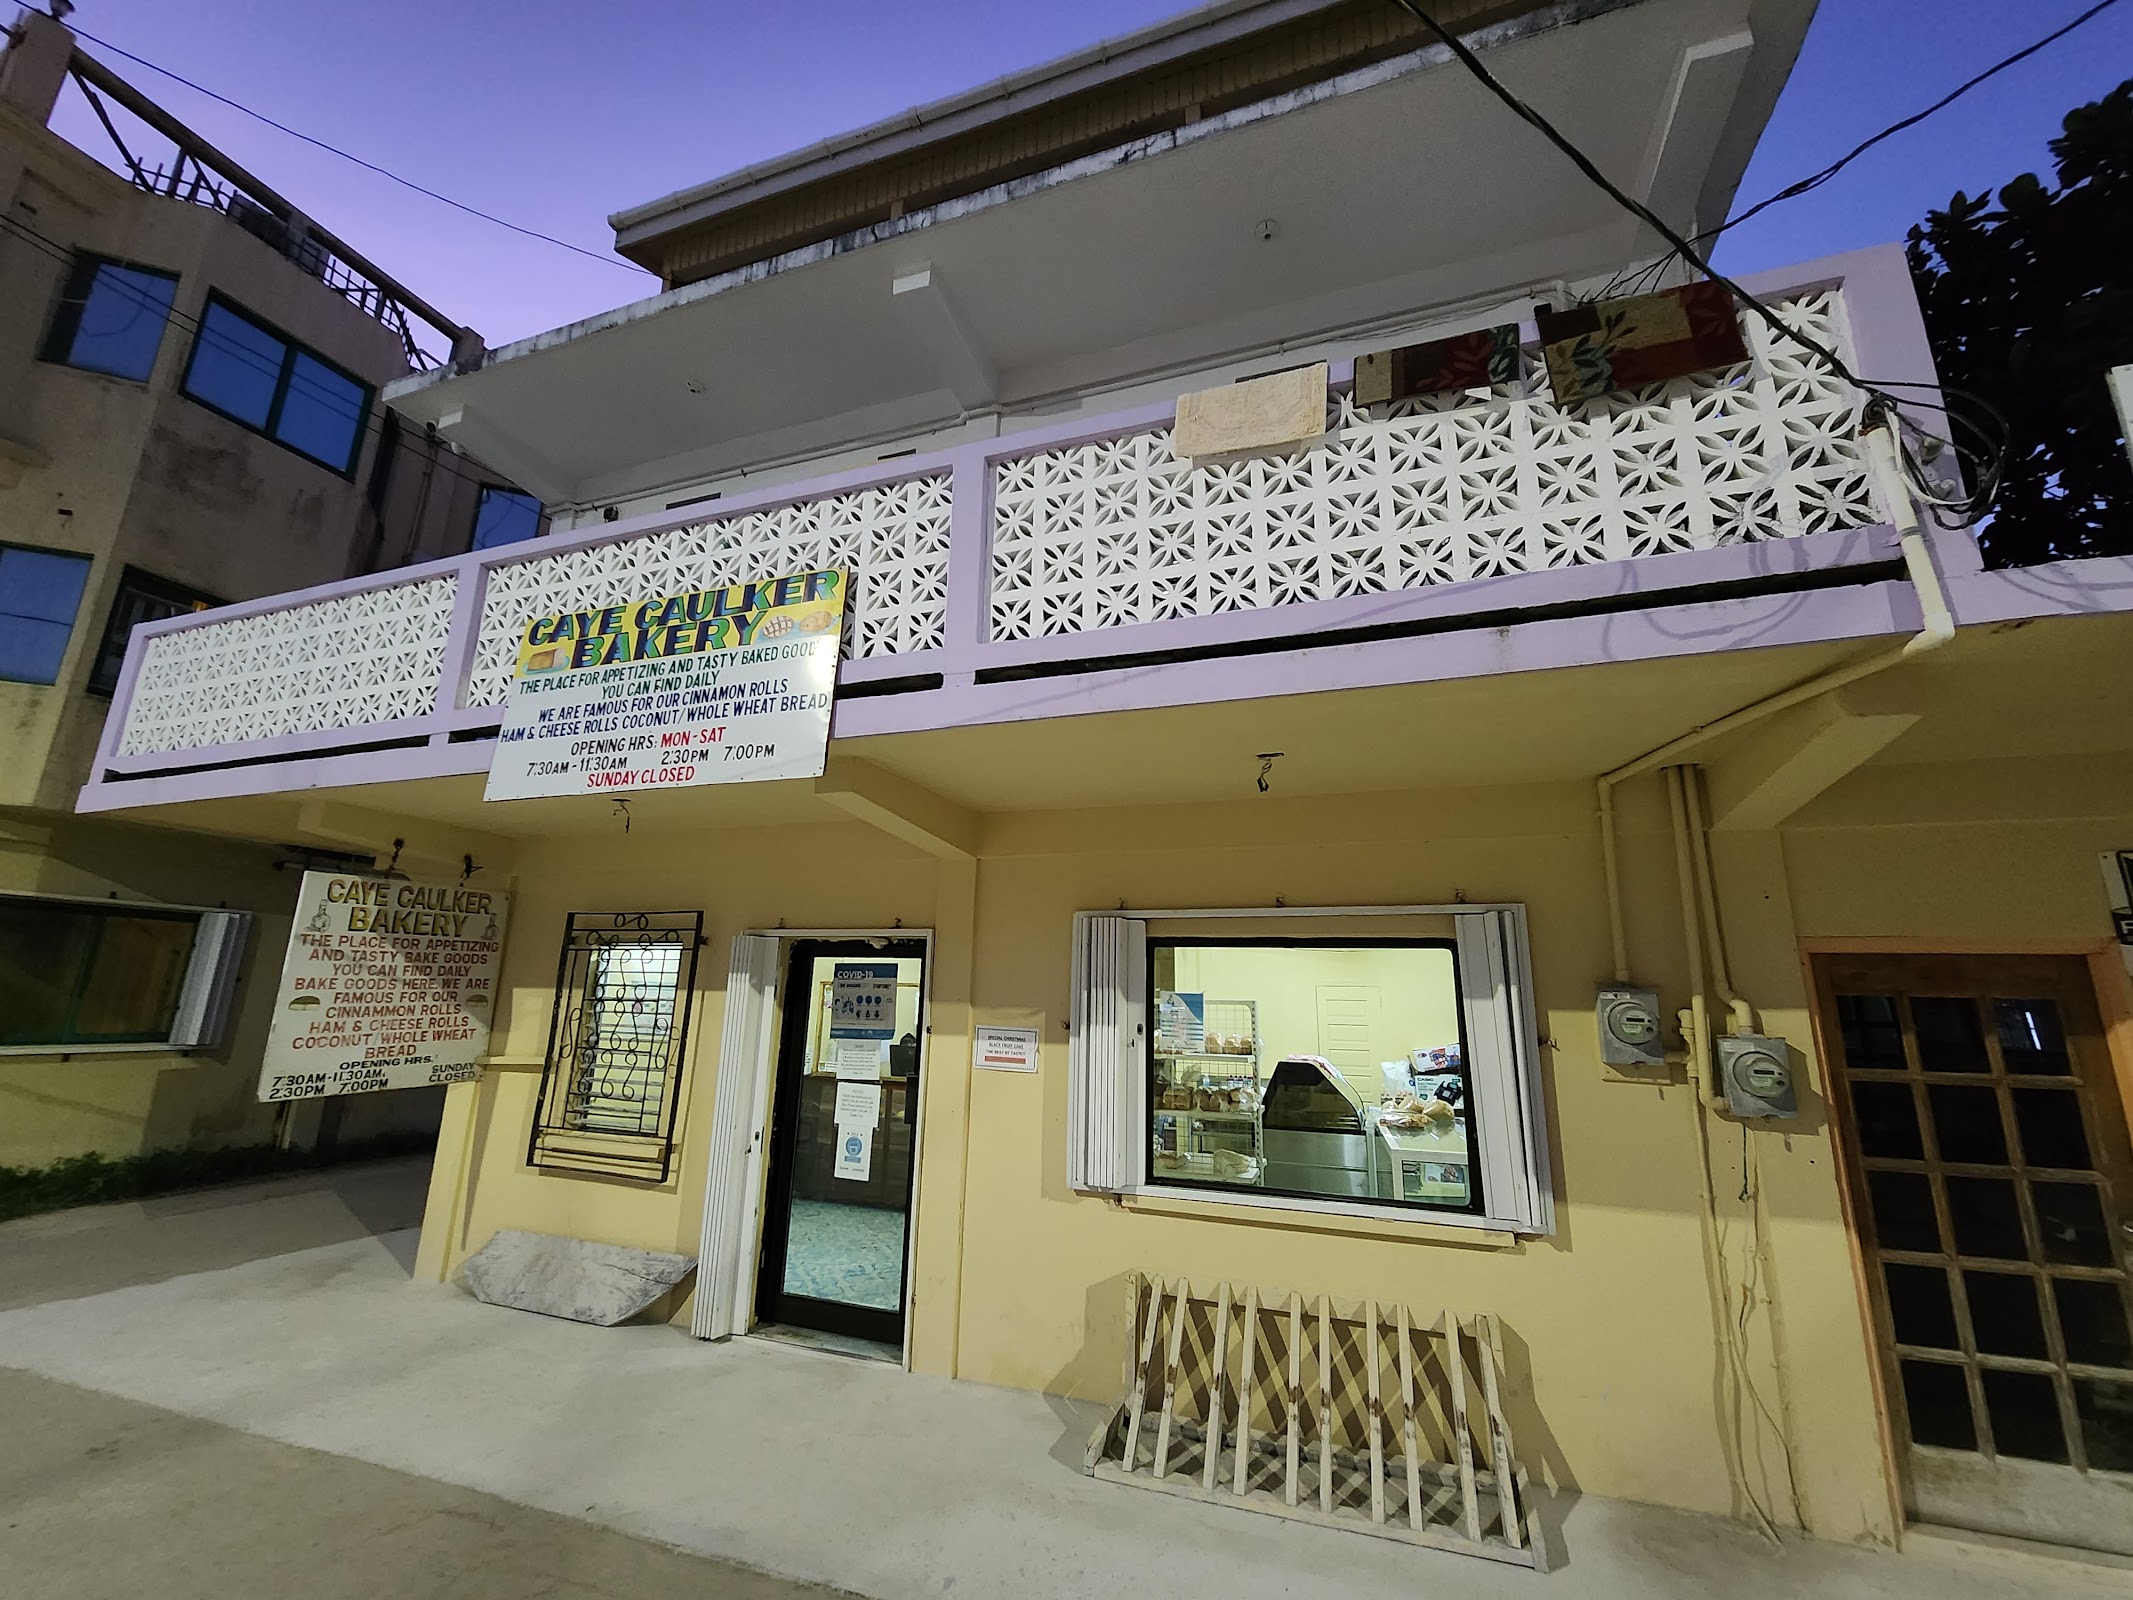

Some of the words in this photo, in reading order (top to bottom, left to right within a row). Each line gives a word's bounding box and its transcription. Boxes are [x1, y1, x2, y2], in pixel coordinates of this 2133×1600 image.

[529, 606, 627, 646] CAYE
[635, 570, 840, 630] CAULKER
[570, 610, 769, 669] BAKERY
[519, 679, 542, 695] THE
[542, 675, 577, 692] PLACE
[578, 671, 600, 687] FOR
[600, 661, 665, 684] APPETIZING
[668, 657, 694, 675] AND
[697, 652, 738, 670] TASTY
[741, 646, 778, 665] BAKED
[782, 640, 820, 658] GOOD
[602, 685, 625, 699] YOU
[627, 680, 652, 697] CAN
[653, 676, 682, 693] FIND
[684, 670, 720, 690] DAILY
[538, 708, 555, 723] WE
[557, 705, 582, 721] ARE
[583, 699, 628, 718] FAMOUS
[631, 696, 654, 713] FOR
[656, 692, 680, 709] OUR
[682, 683, 747, 705] CINNAMON
[750, 678, 789, 698] ROLLS
[500, 727, 525, 743] HAM
[526, 726, 535, 740] &
[538, 721, 582, 739] CHEESE
[583, 717, 618, 735] ROLLS
[733, 697, 777, 717] WHEAT
[780, 693, 828, 712] BREAD
[570, 737, 626, 756] OPENING
[628, 734, 658, 751] HRS:
[586, 770, 639, 788] SUNDAY
[641, 766, 695, 784] CLOSED
[327, 879, 391, 907] CAYE
[397, 885, 492, 915] CAULKER
[347, 906, 468, 938] BAKERY
[300, 933, 333, 947] THE
[338, 935, 388, 949] PLACE
[391, 937, 421, 950] FOR
[425, 939, 499, 953] APPETIZING
[308, 949, 345, 961] AND
[351, 949, 400, 963] TASTY
[404, 951, 440, 964] BAKE
[444, 953, 488, 965] GOODS
[332, 963, 363, 976] YOU
[367, 964, 398, 977] CAN
[402, 964, 433, 977] FIND
[437, 965, 472, 977] DAILY
[837, 970, 874, 978] COVID-19
[294, 977, 338, 990] BAKE
[344, 978, 397, 990] GOODS
[441, 978, 461, 990] WE
[465, 978, 490, 990] ARE
[333, 991, 395, 1004] FAMOUS
[399, 991, 427, 1003] FOR
[431, 991, 458, 1002] OUR
[325, 1005, 416, 1018] CINNAMMON
[420, 1003, 462, 1015] ROLLS
[309, 1021, 346, 1034] HAM
[352, 1020, 362, 1032] &
[369, 1018, 424, 1031] CHEESE
[428, 1016, 469, 1029] ROLLS
[432, 1028, 477, 1041] WHEAT
[364, 1044, 417, 1059] BREAD
[339, 1058, 401, 1070] OPENING
[431, 1062, 475, 1074] SUNDAY
[428, 1071, 476, 1083] CLOSED
